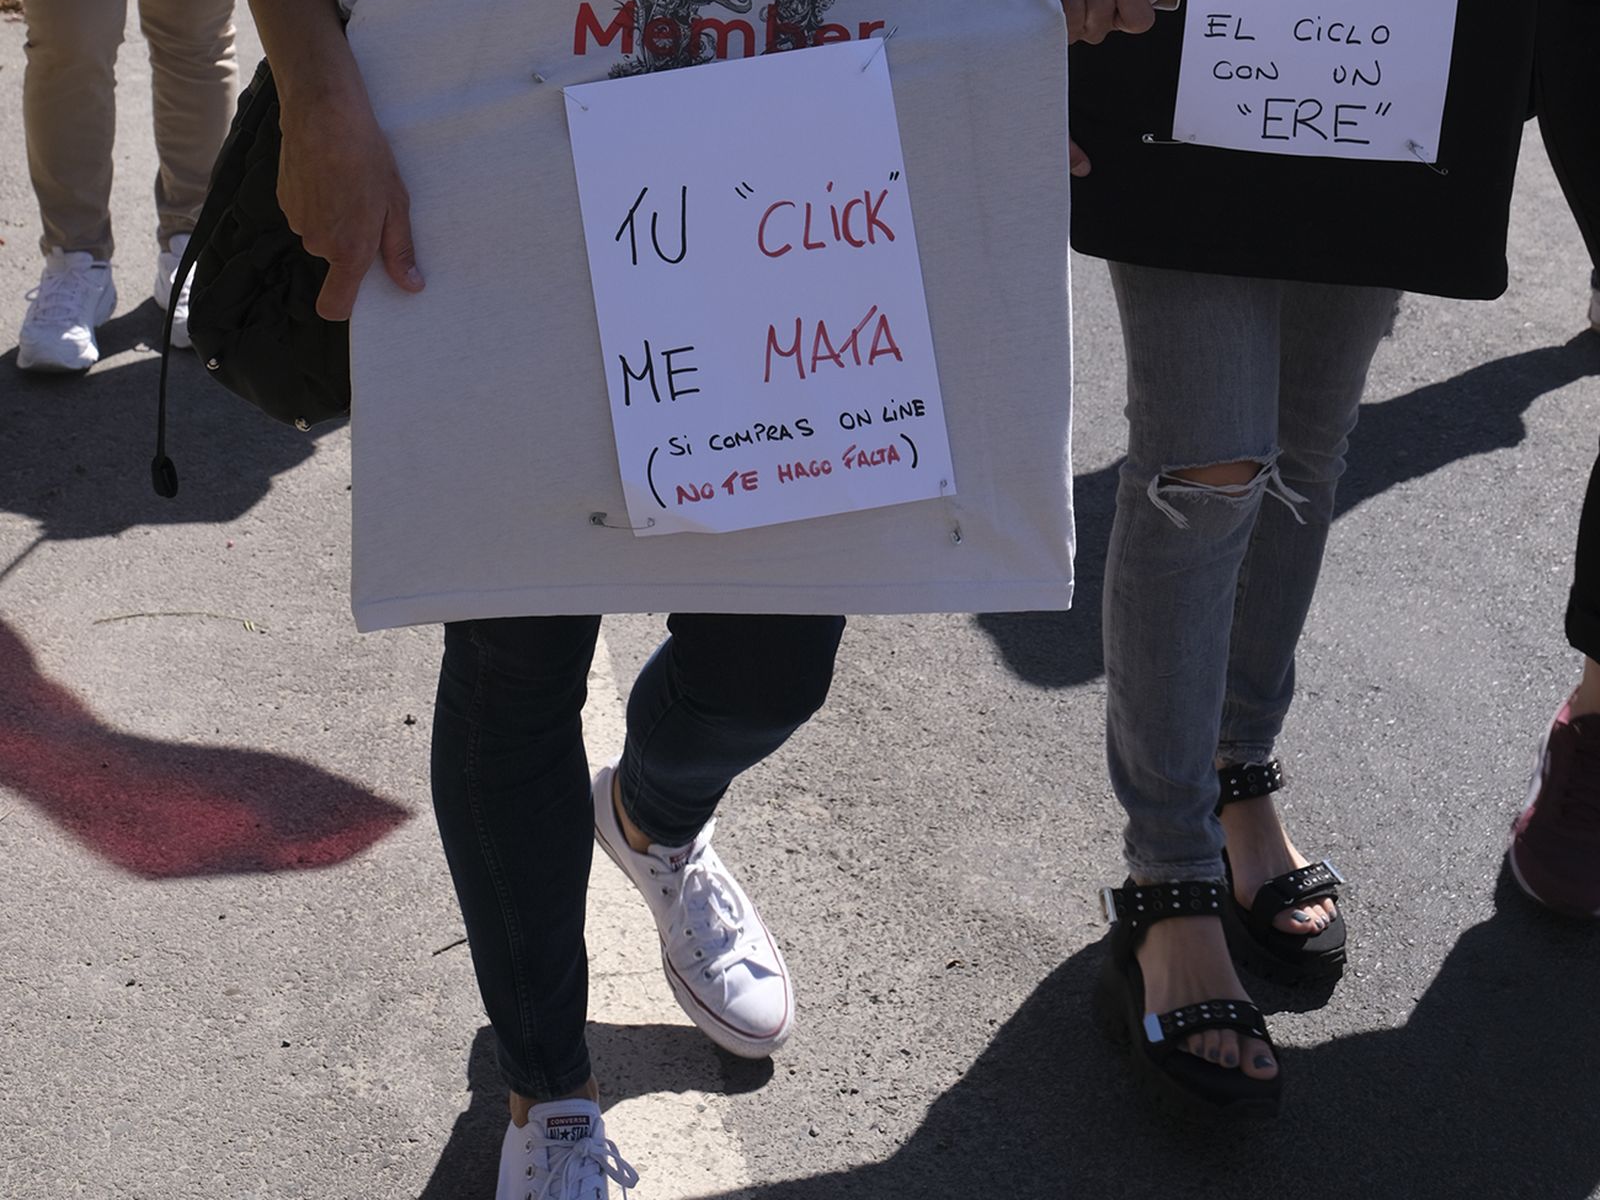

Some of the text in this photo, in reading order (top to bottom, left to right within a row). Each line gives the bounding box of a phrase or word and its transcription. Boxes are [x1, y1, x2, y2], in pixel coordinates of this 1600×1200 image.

[1204, 14, 1255, 40] EL
[1213, 60, 1381, 86] CON UN
[615, 186, 687, 265] TU
[619, 305, 903, 406] ME MATA
[709, 419, 814, 450] COMPRAS
[840, 410, 872, 430] ON
[722, 471, 758, 494] TE
[778, 461, 832, 483] HAGO
[549, 1127, 560, 1139] ALL
[550, 1117, 588, 1125] CONVERSE
